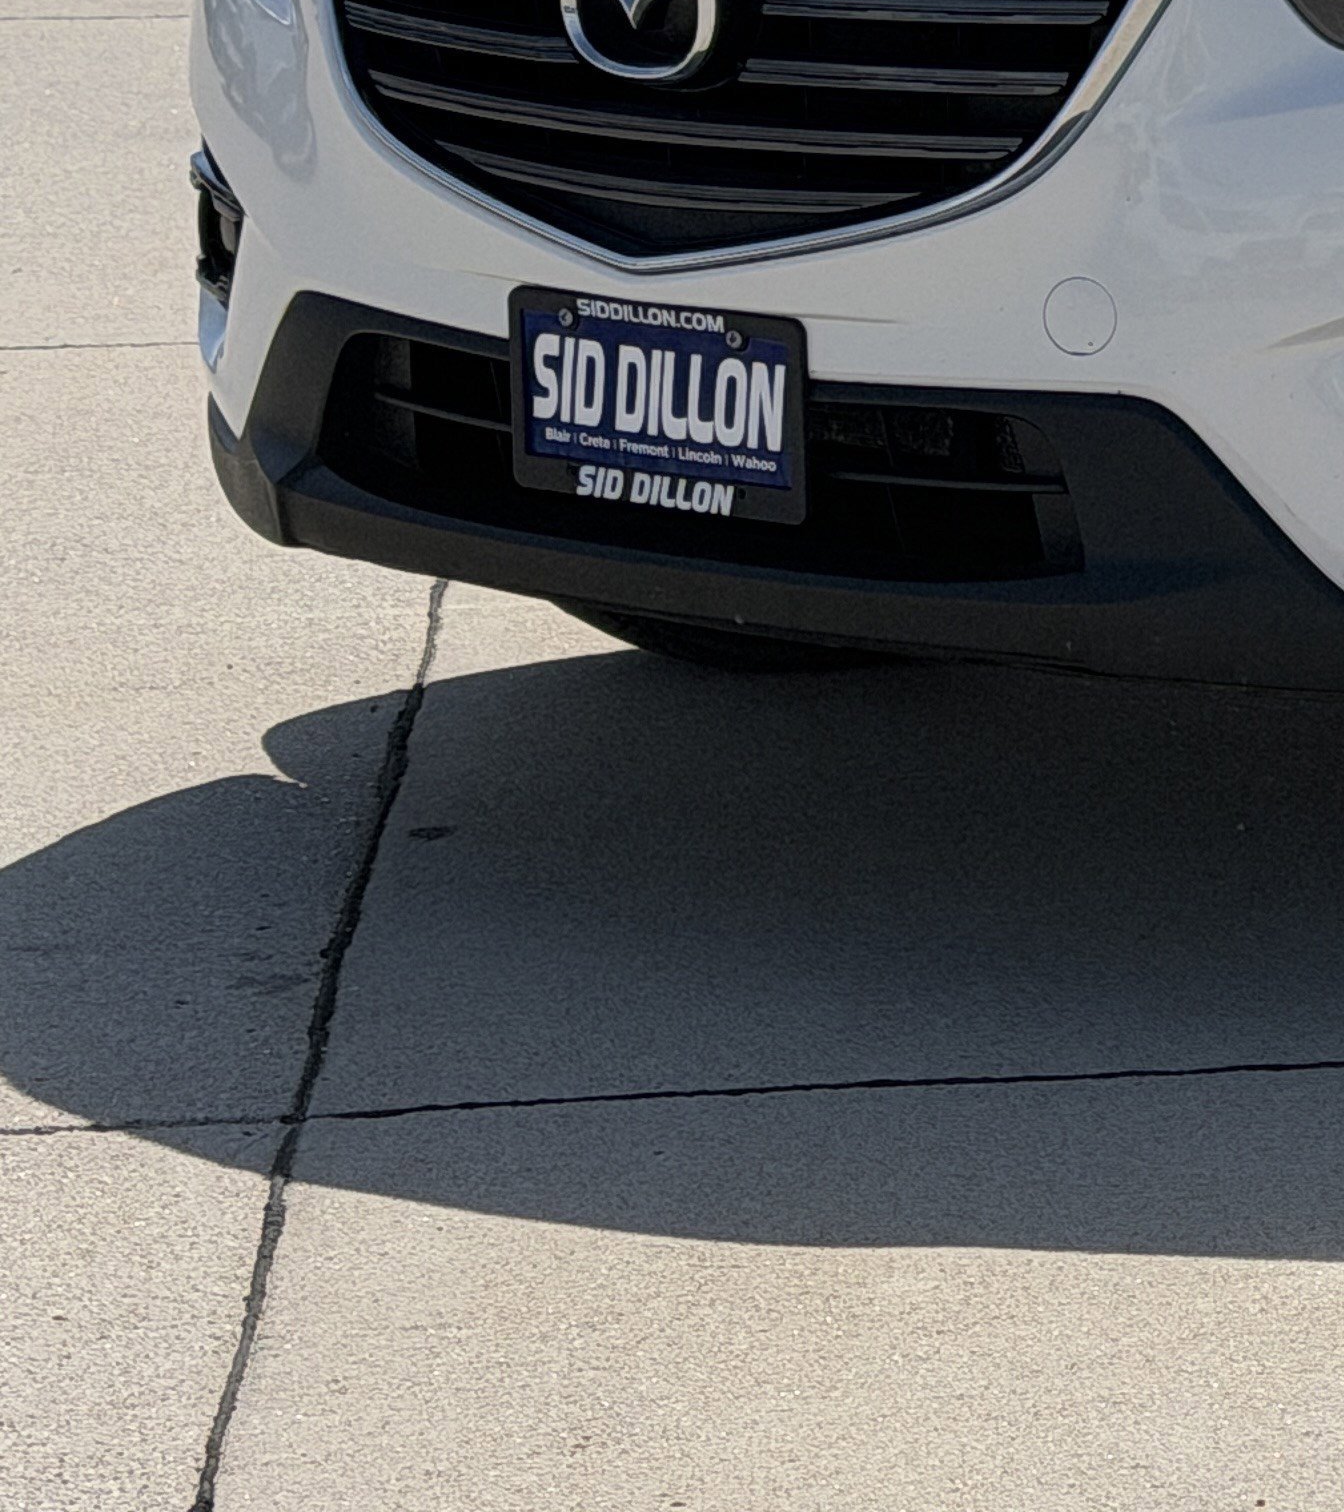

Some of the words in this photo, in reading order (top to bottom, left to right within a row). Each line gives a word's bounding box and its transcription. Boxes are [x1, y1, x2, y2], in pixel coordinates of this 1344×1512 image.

[576, 298, 725, 334] SIDDILLON.COM
[532, 333, 606, 428] SID
[615, 344, 786, 452] DILLON
[545, 426, 571, 443] Blair
[619, 438, 670, 459] Fremont
[678, 446, 723, 465] Lincoln
[730, 452, 778, 473] Wahoo
[576, 464, 624, 501] SID
[629, 471, 735, 517] DILLON
